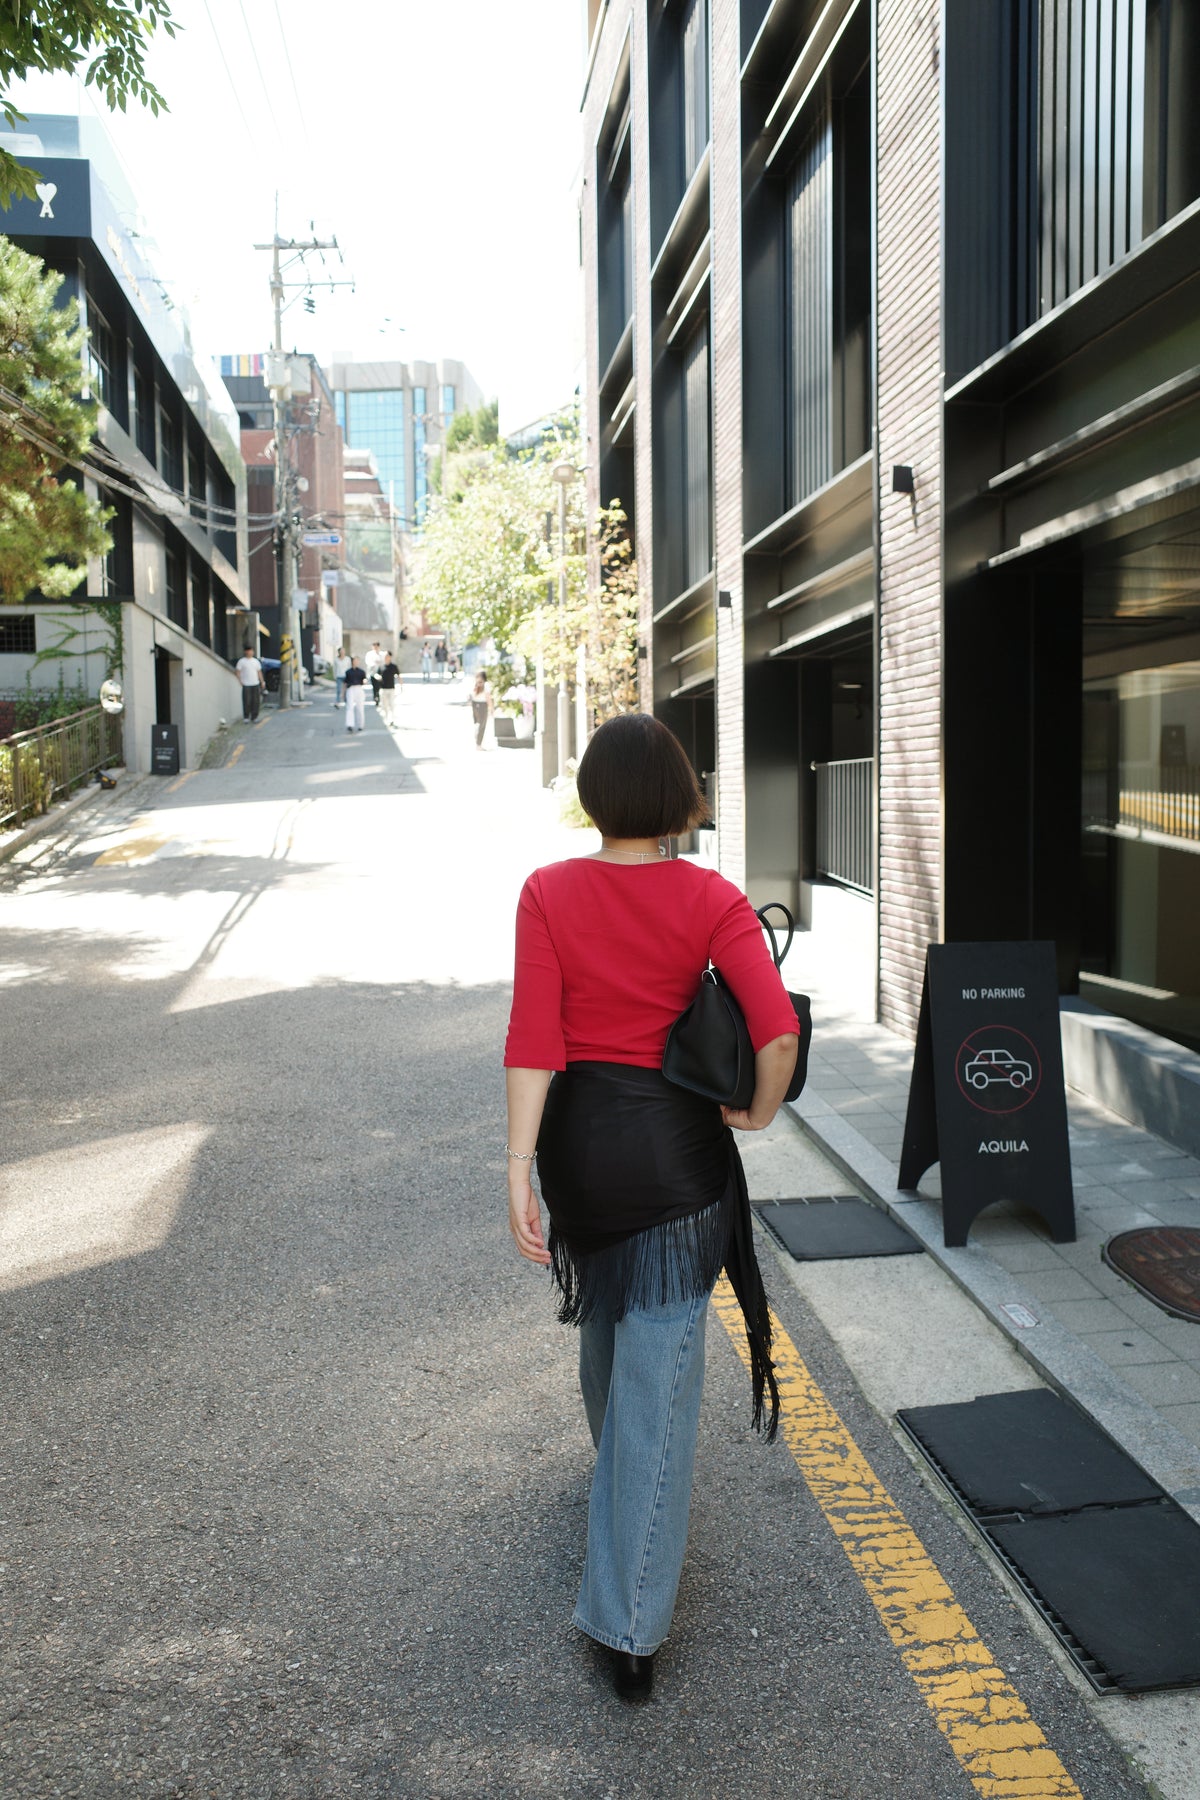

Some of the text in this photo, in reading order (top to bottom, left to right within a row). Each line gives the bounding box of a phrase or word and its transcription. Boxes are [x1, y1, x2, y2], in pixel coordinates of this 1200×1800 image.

[962, 987, 1026, 1000] NO PARKING
[978, 1140, 1030, 1154] AQUILA
